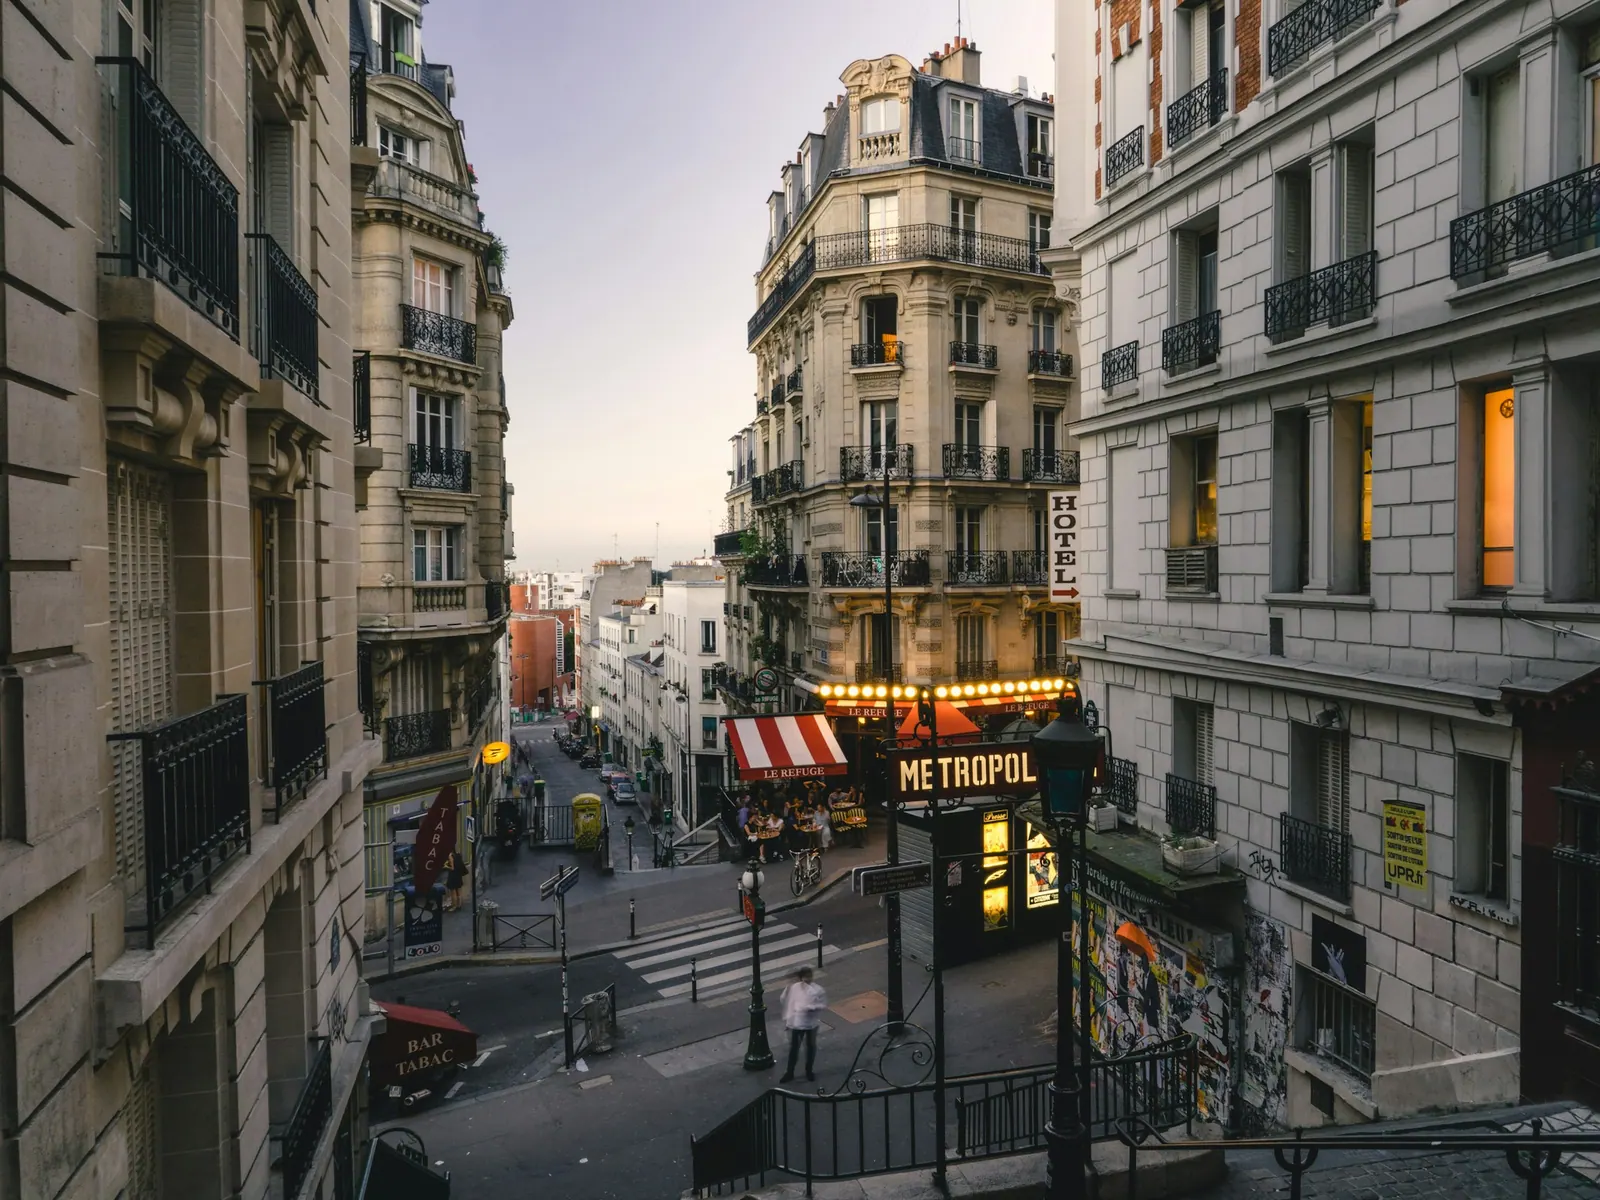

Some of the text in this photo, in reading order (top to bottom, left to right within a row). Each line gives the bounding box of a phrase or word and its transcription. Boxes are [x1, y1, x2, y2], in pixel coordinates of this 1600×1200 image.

[1052, 496, 1077, 584] HOTEL
[848, 708, 903, 717] LE REFUE
[1005, 704, 1016, 712] LE
[764, 766, 825, 779] LE REFUGE
[900, 752, 1097, 792] METROPOL
[425, 807, 448, 871] TABAC
[1388, 862, 1423, 885] UPR.fr
[408, 944, 440, 957] LOTO
[407, 1032, 444, 1054] BAR
[395, 1049, 455, 1076] TABAC
